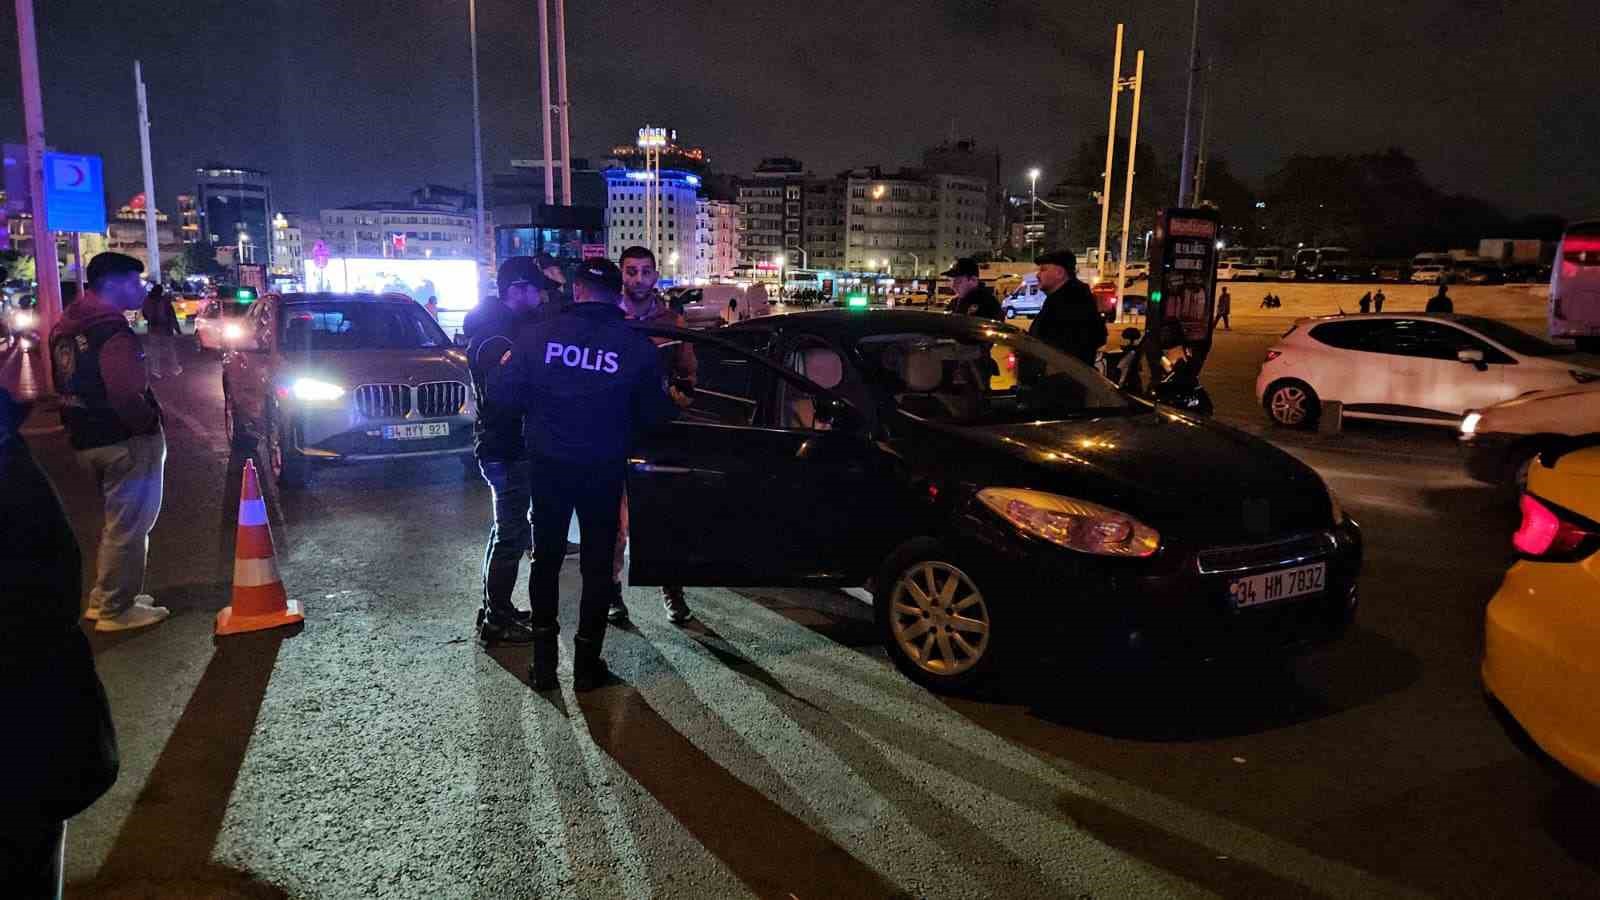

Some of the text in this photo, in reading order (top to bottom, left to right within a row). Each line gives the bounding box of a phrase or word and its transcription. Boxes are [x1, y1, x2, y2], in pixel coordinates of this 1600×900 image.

[428, 422, 447, 434] 921
[1238, 579, 1257, 604] 34
[1288, 566, 1322, 595] 7832
